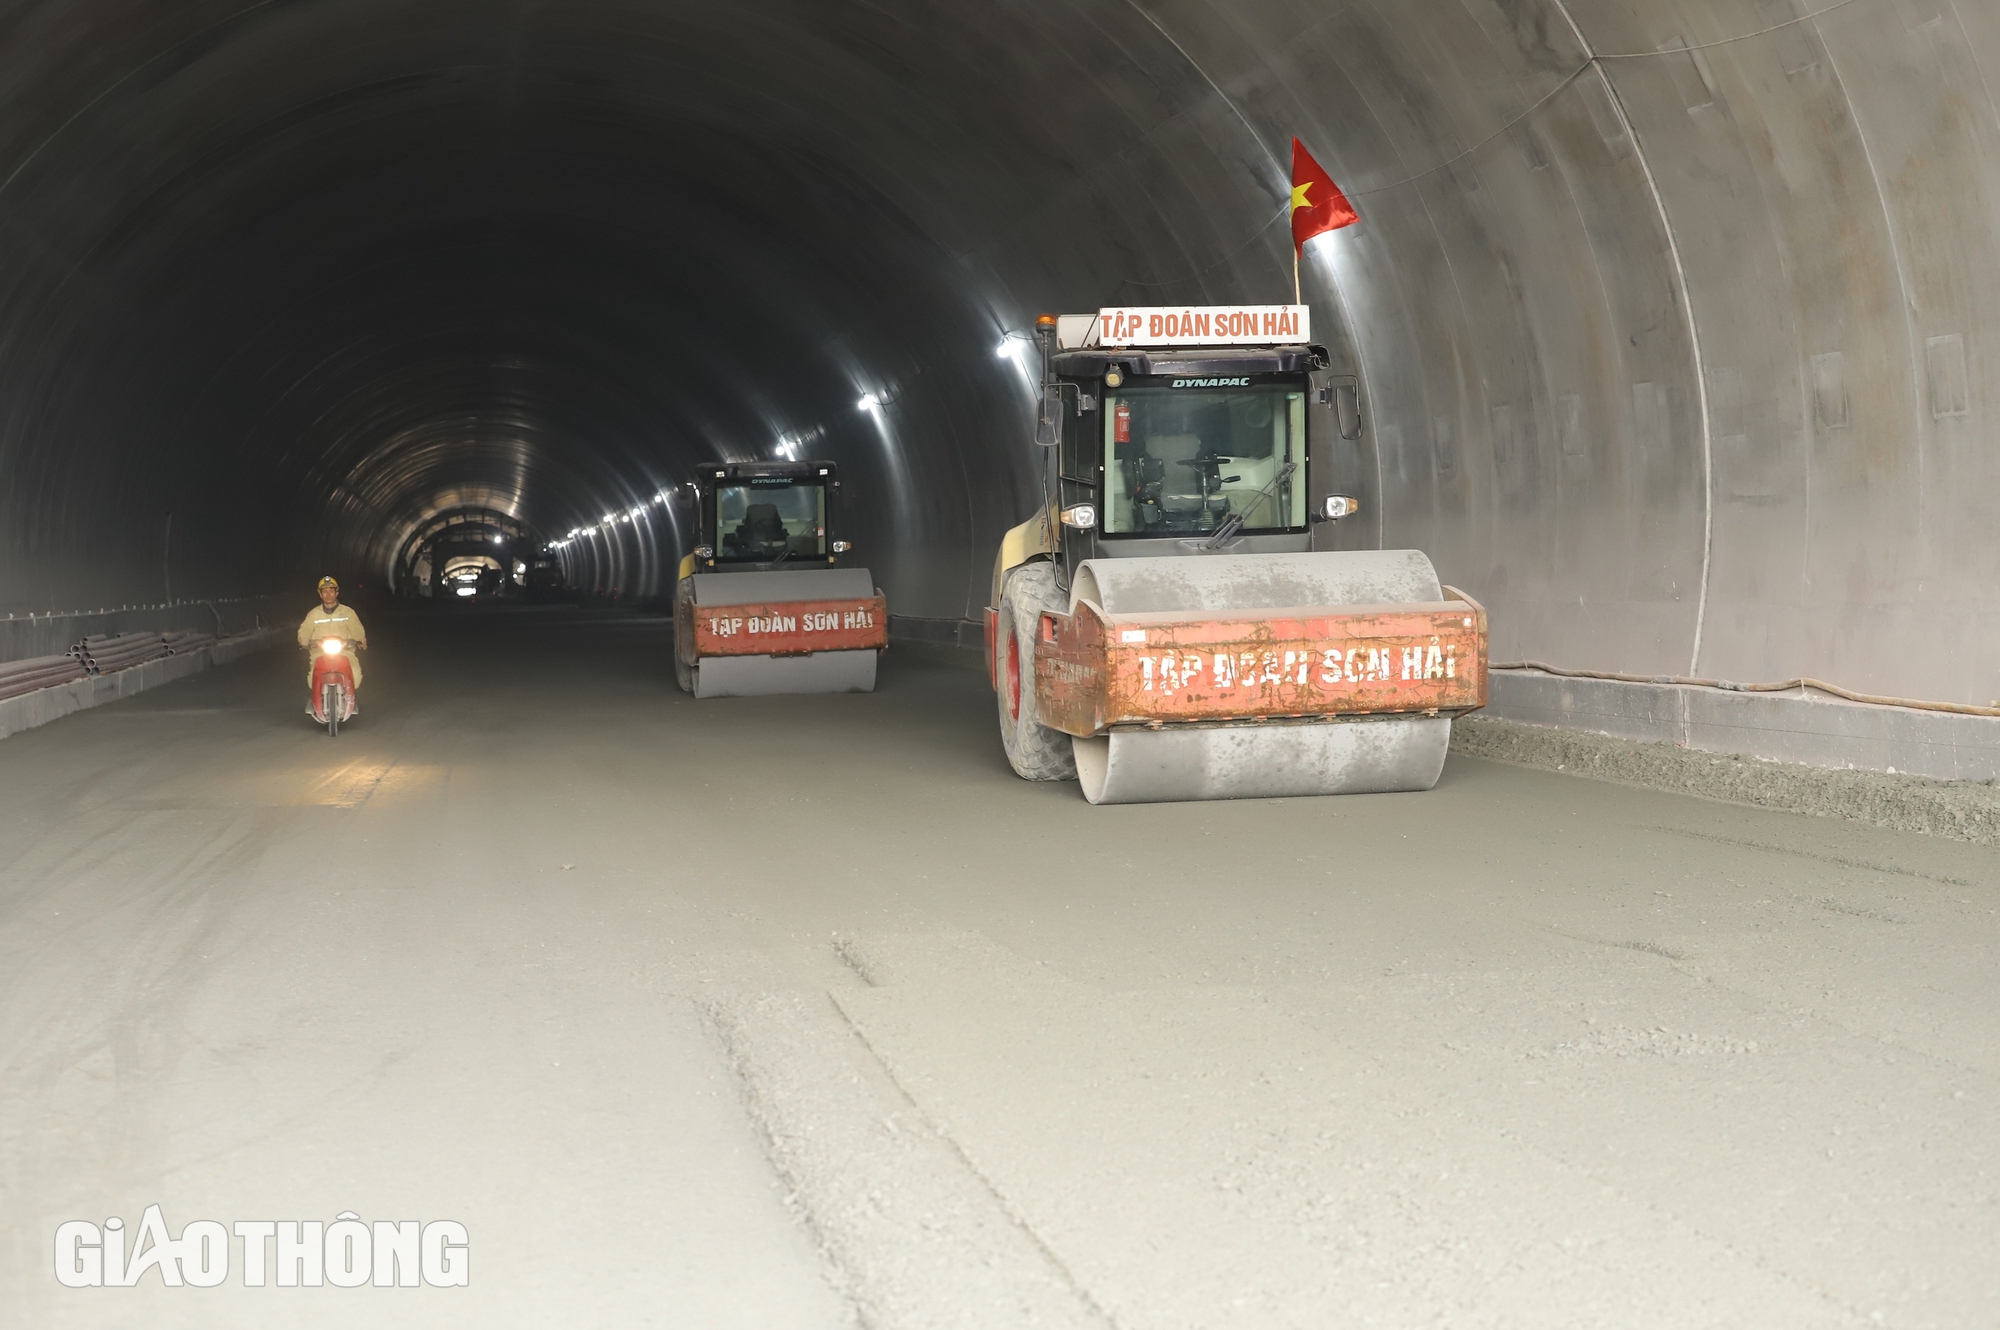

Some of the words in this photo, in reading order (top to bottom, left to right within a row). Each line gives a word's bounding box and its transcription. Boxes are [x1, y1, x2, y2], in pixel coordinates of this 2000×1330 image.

[1101, 310, 1142, 341] TẬP
[1215, 311, 1259, 336] SƠN
[1264, 306, 1299, 336] HẢI
[1172, 377, 1250, 388] DYNAPAC
[1401, 637, 1456, 681] HẢI
